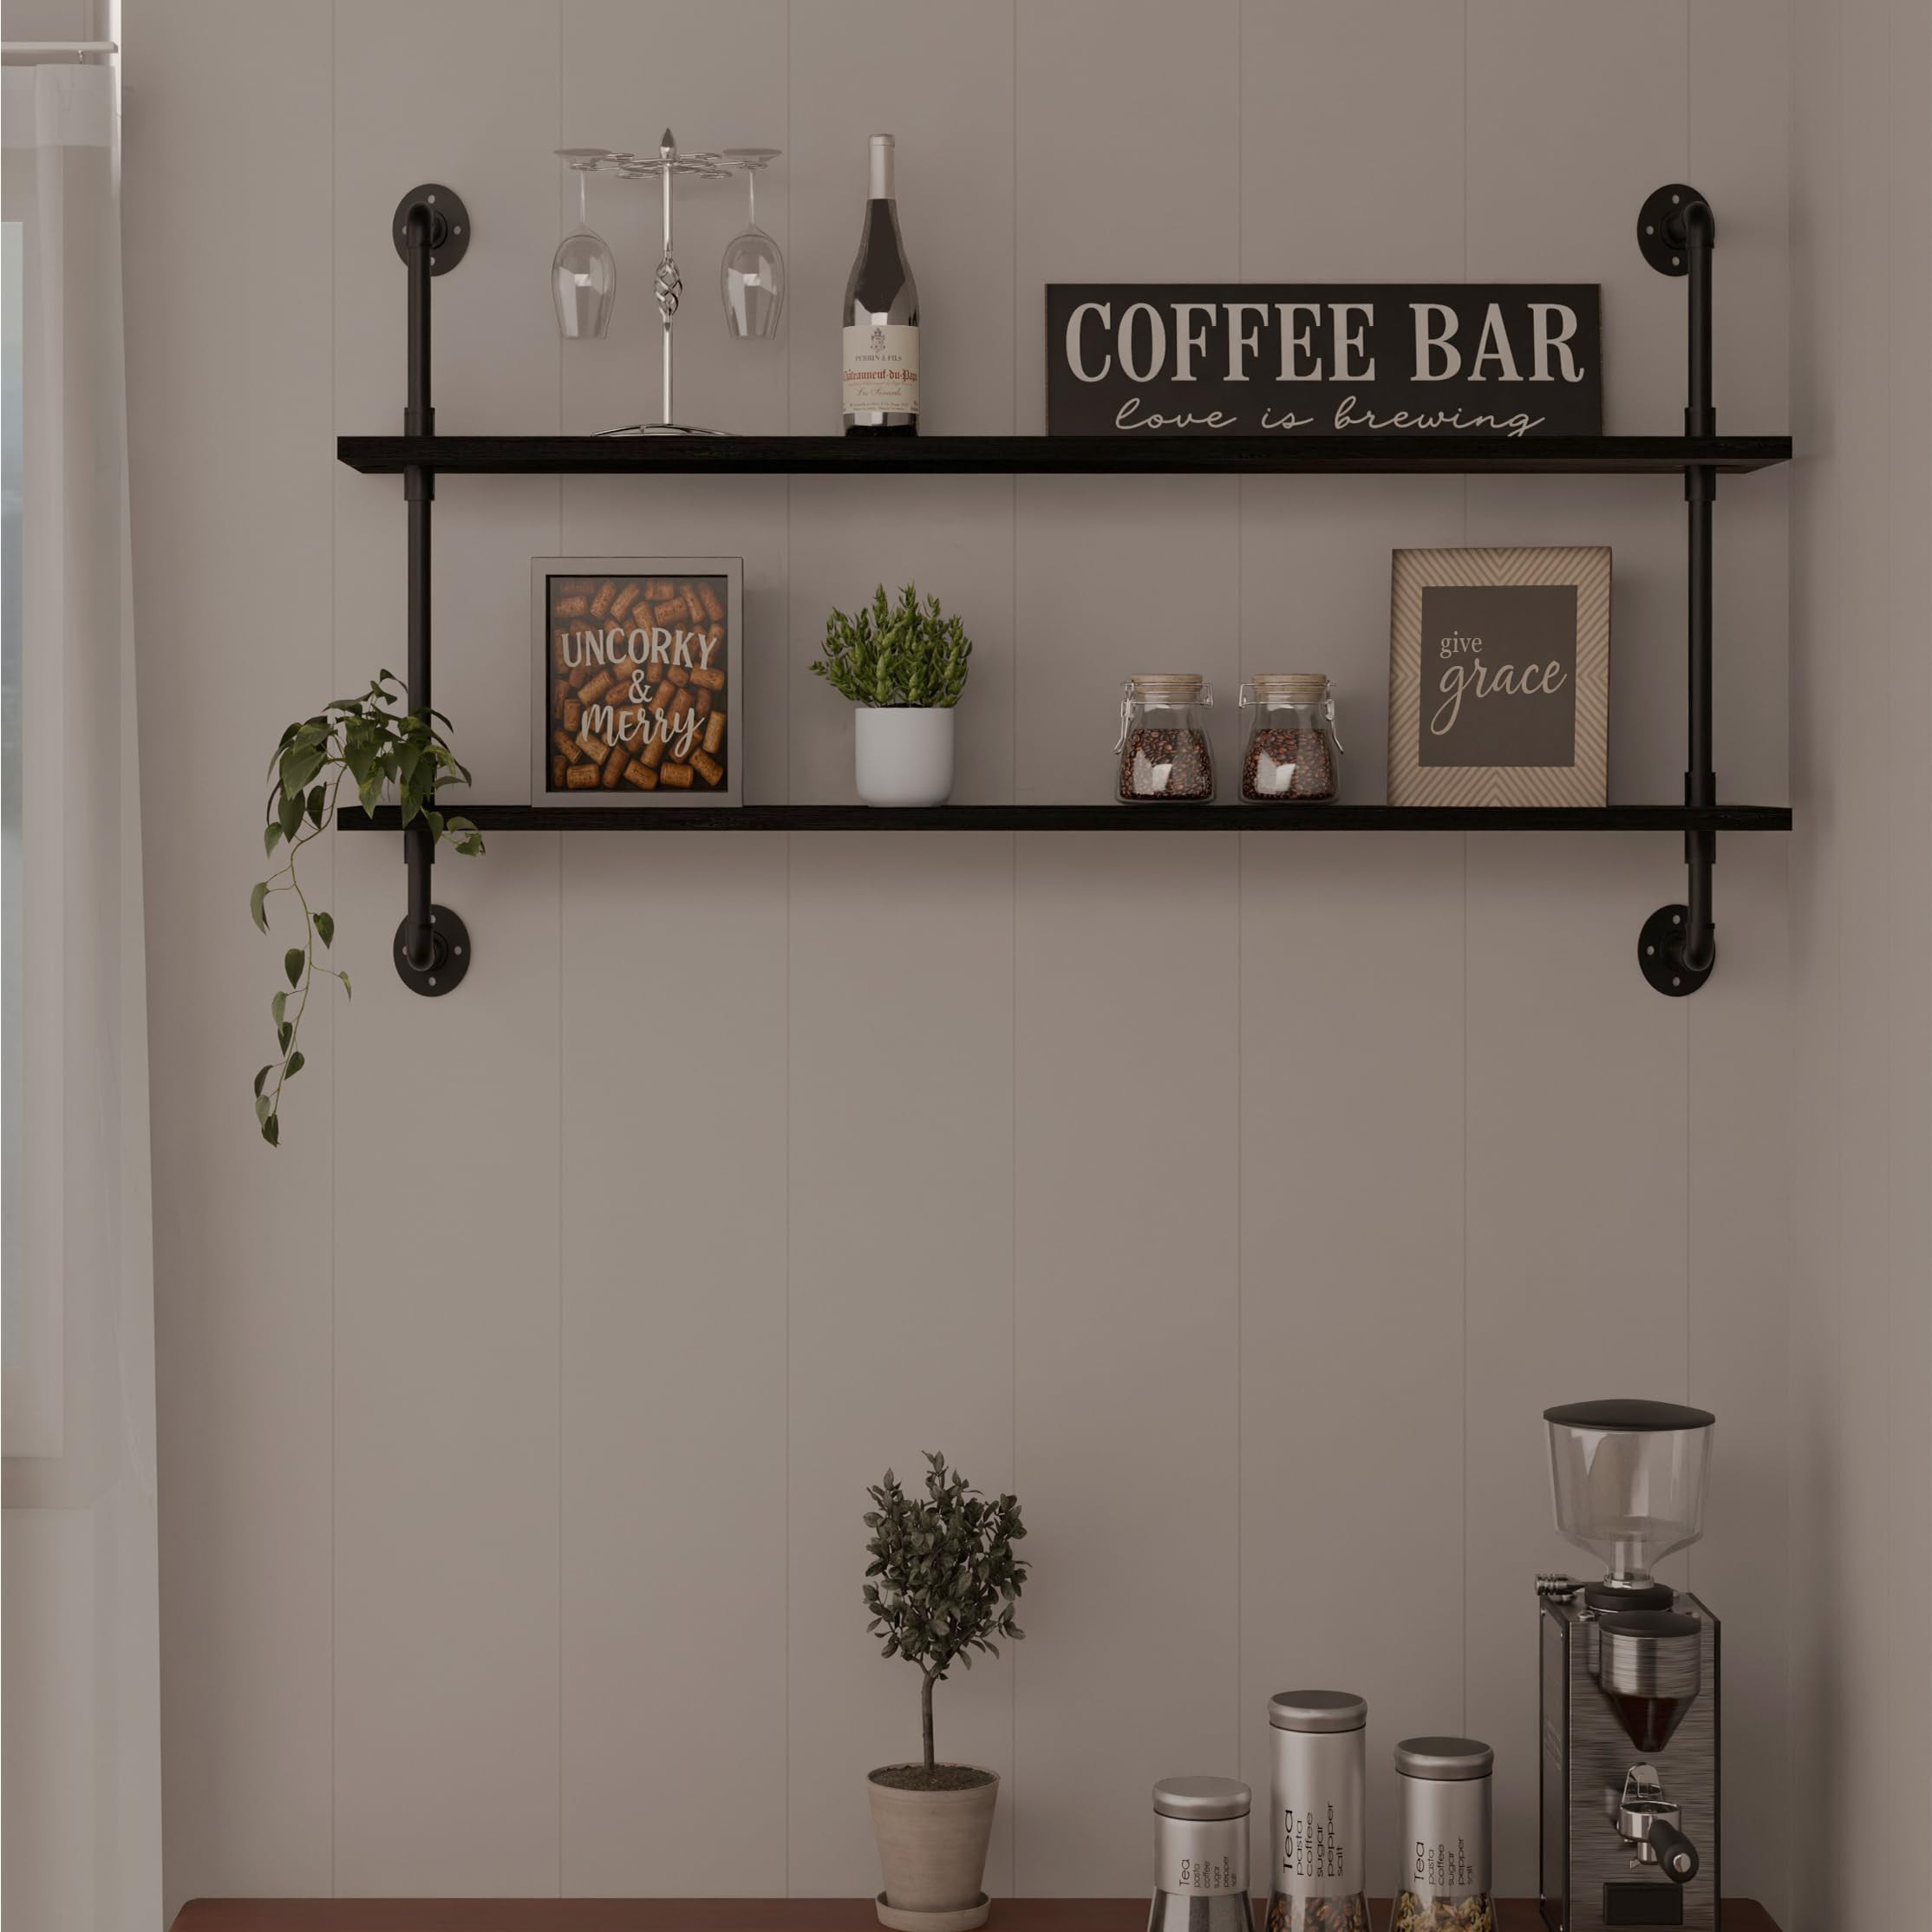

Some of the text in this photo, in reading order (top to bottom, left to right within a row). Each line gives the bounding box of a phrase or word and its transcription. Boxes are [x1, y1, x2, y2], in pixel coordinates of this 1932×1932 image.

[1065, 302, 1585, 382] COFFEE BAR
[1115, 395, 1545, 437] love is brewing
[561, 627, 718, 670] UNCORKY
[1439, 631, 1483, 659] give
[629, 669, 653, 703] &
[1431, 657, 1568, 735] grace
[1283, 1809, 1293, 1873] Tea
[1296, 1820, 1304, 1876] pasta
[1179, 1859, 1190, 1886] Tea
[1413, 1842, 1425, 1883] Tea
[1427, 1849, 1436, 1884] pasta
